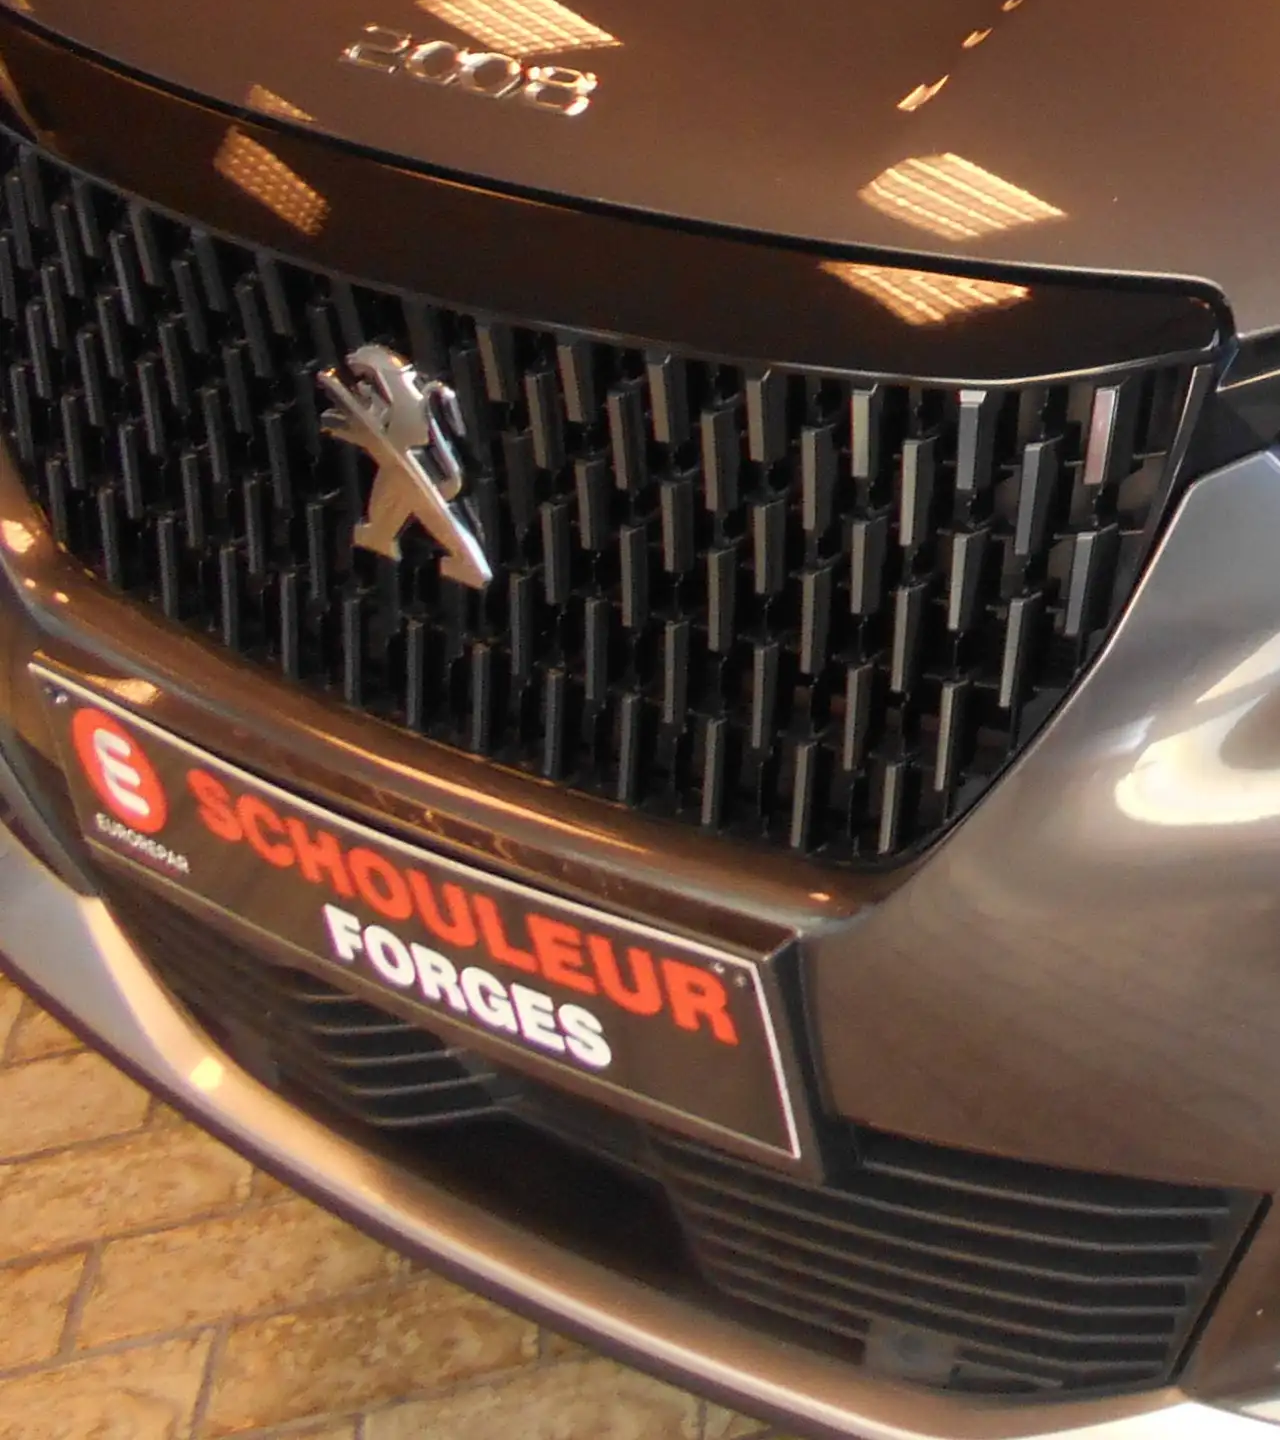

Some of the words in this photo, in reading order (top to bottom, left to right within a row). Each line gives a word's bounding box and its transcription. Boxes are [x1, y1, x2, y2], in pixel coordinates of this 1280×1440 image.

[338, 23, 598, 116] 2008
[187, 768, 740, 1046] SCHOULEUR
[321, 904, 612, 1067] FORGES
